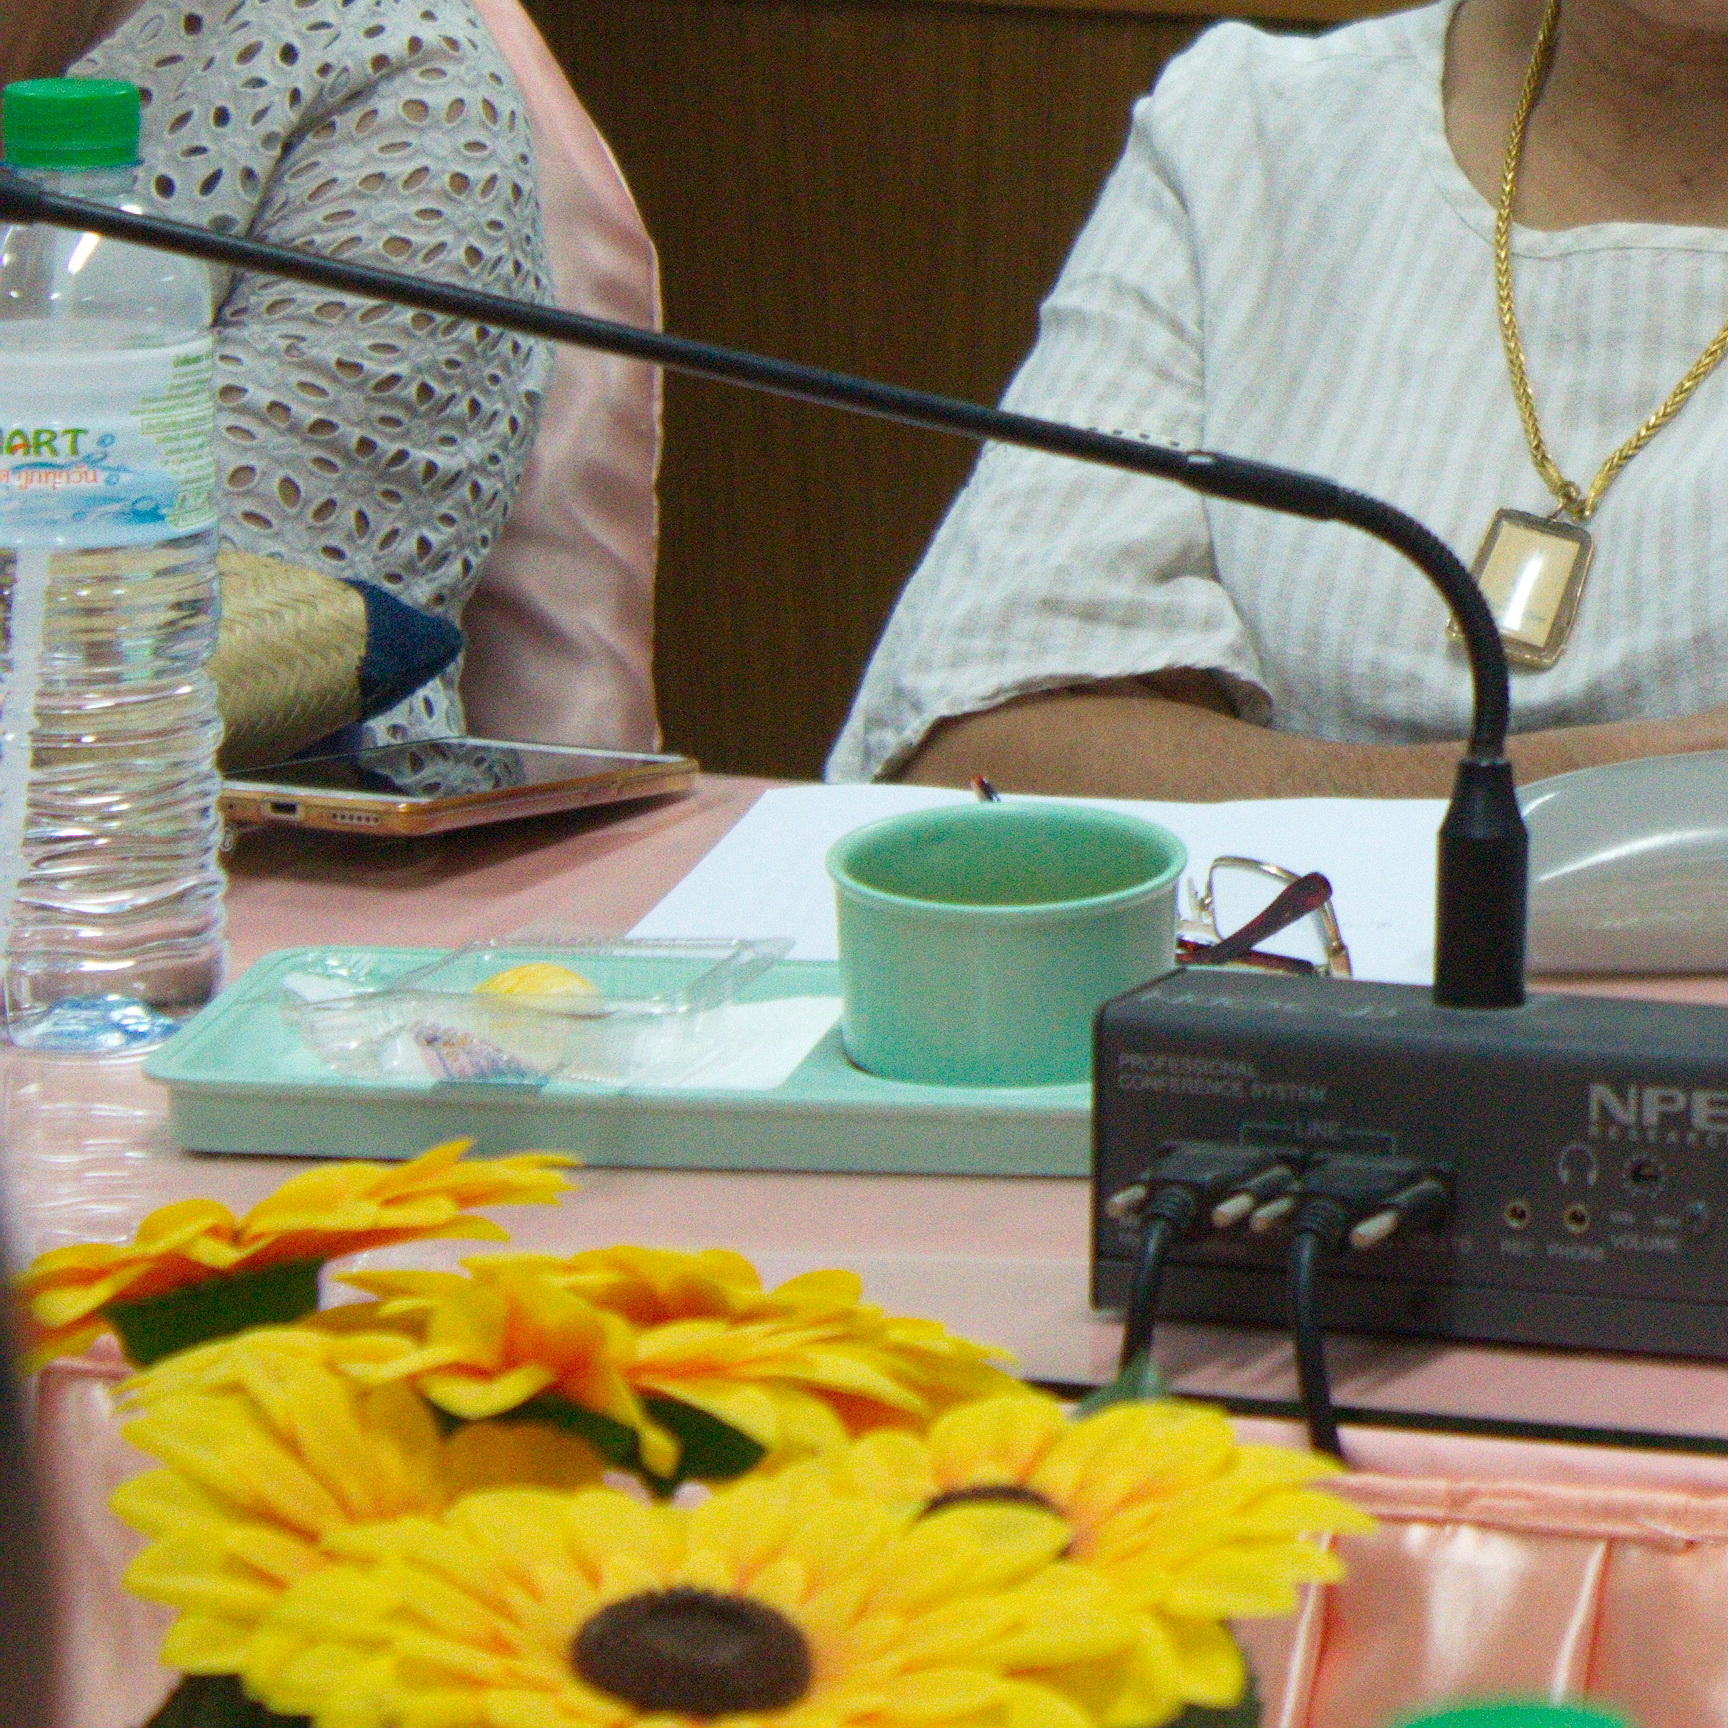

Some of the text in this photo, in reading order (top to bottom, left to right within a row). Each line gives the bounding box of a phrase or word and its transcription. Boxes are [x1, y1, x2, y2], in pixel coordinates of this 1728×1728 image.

[0, 427, 88, 459] ART
[1117, 1052, 1260, 1078] PROFESSIONAL
[1116, 1073, 1328, 1104] CONFERENCE SYSTEM
[1293, 1120, 1343, 1141] LINE
[1608, 1233, 1681, 1255] VOLUME
